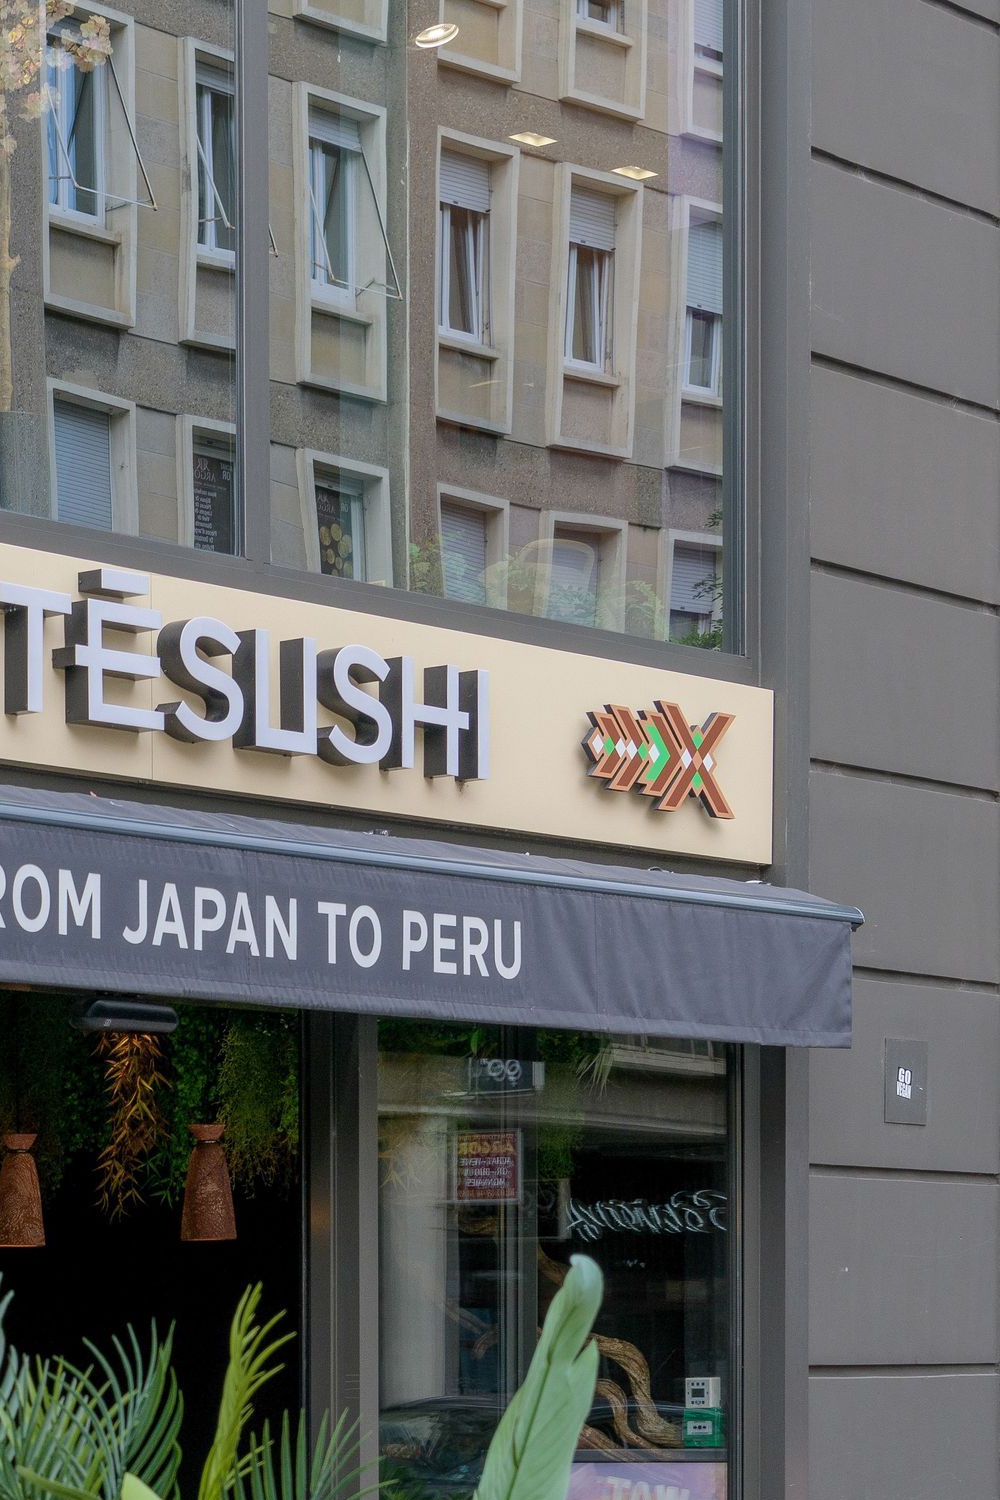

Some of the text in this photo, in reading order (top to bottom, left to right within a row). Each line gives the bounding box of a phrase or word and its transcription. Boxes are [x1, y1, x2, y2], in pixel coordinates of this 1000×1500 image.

[122, 879, 298, 961] JAPAN
[316, 901, 383, 969] TO
[401, 909, 523, 981] PERU
